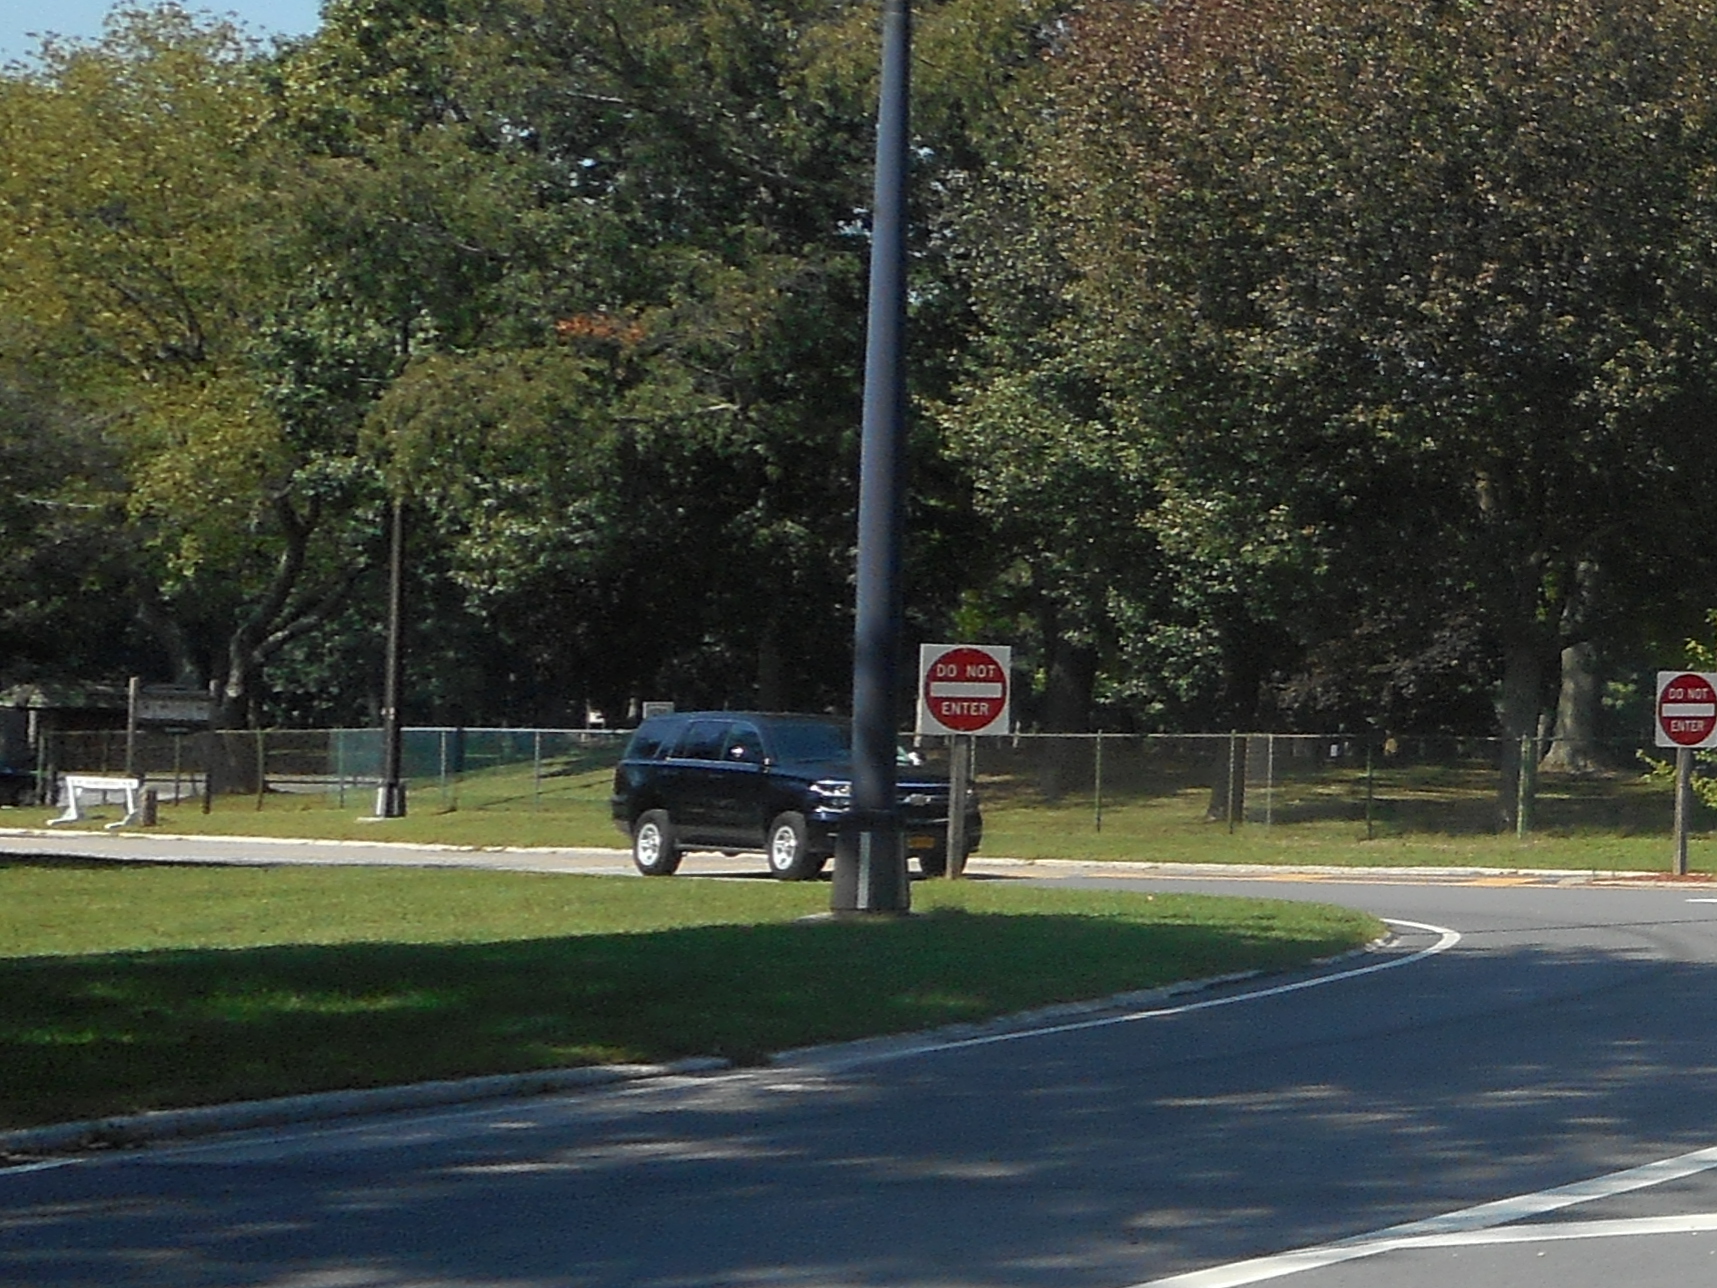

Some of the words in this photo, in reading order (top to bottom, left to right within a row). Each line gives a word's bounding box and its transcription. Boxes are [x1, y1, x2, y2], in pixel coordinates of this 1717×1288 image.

[936, 664, 958, 677] DO
[966, 665, 997, 678] NOT
[1668, 688, 1684, 699] DO
[1687, 688, 1709, 699] NOT
[941, 702, 989, 716] ENTER
[1670, 720, 1704, 732] ENTER
